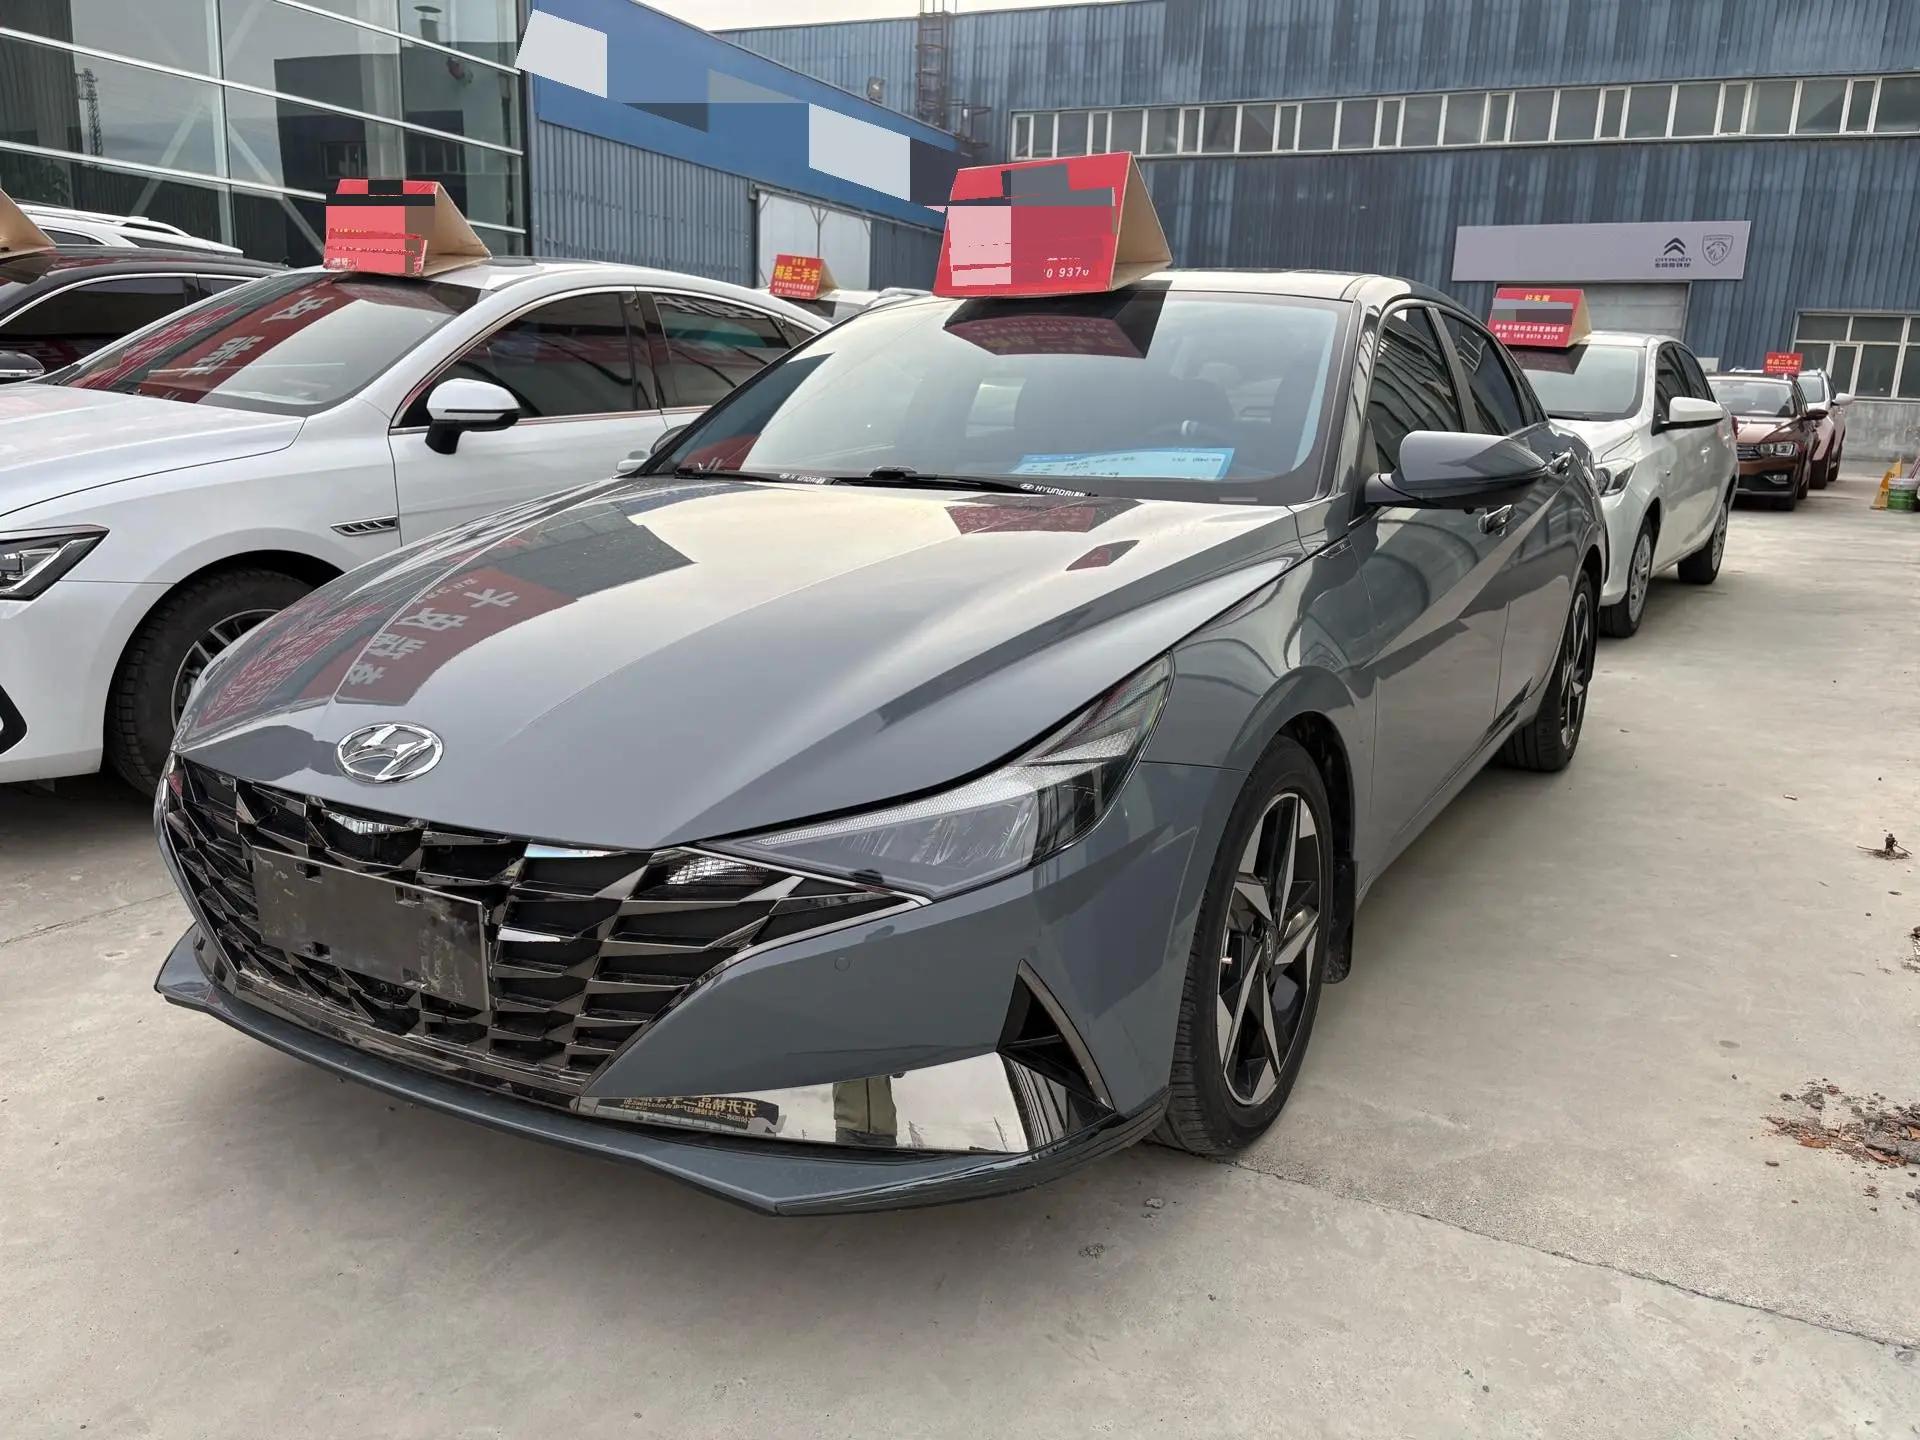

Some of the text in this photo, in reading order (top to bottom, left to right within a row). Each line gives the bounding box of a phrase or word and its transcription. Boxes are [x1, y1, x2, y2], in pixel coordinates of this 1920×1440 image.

[775, 265, 820, 283] 精品二手车
